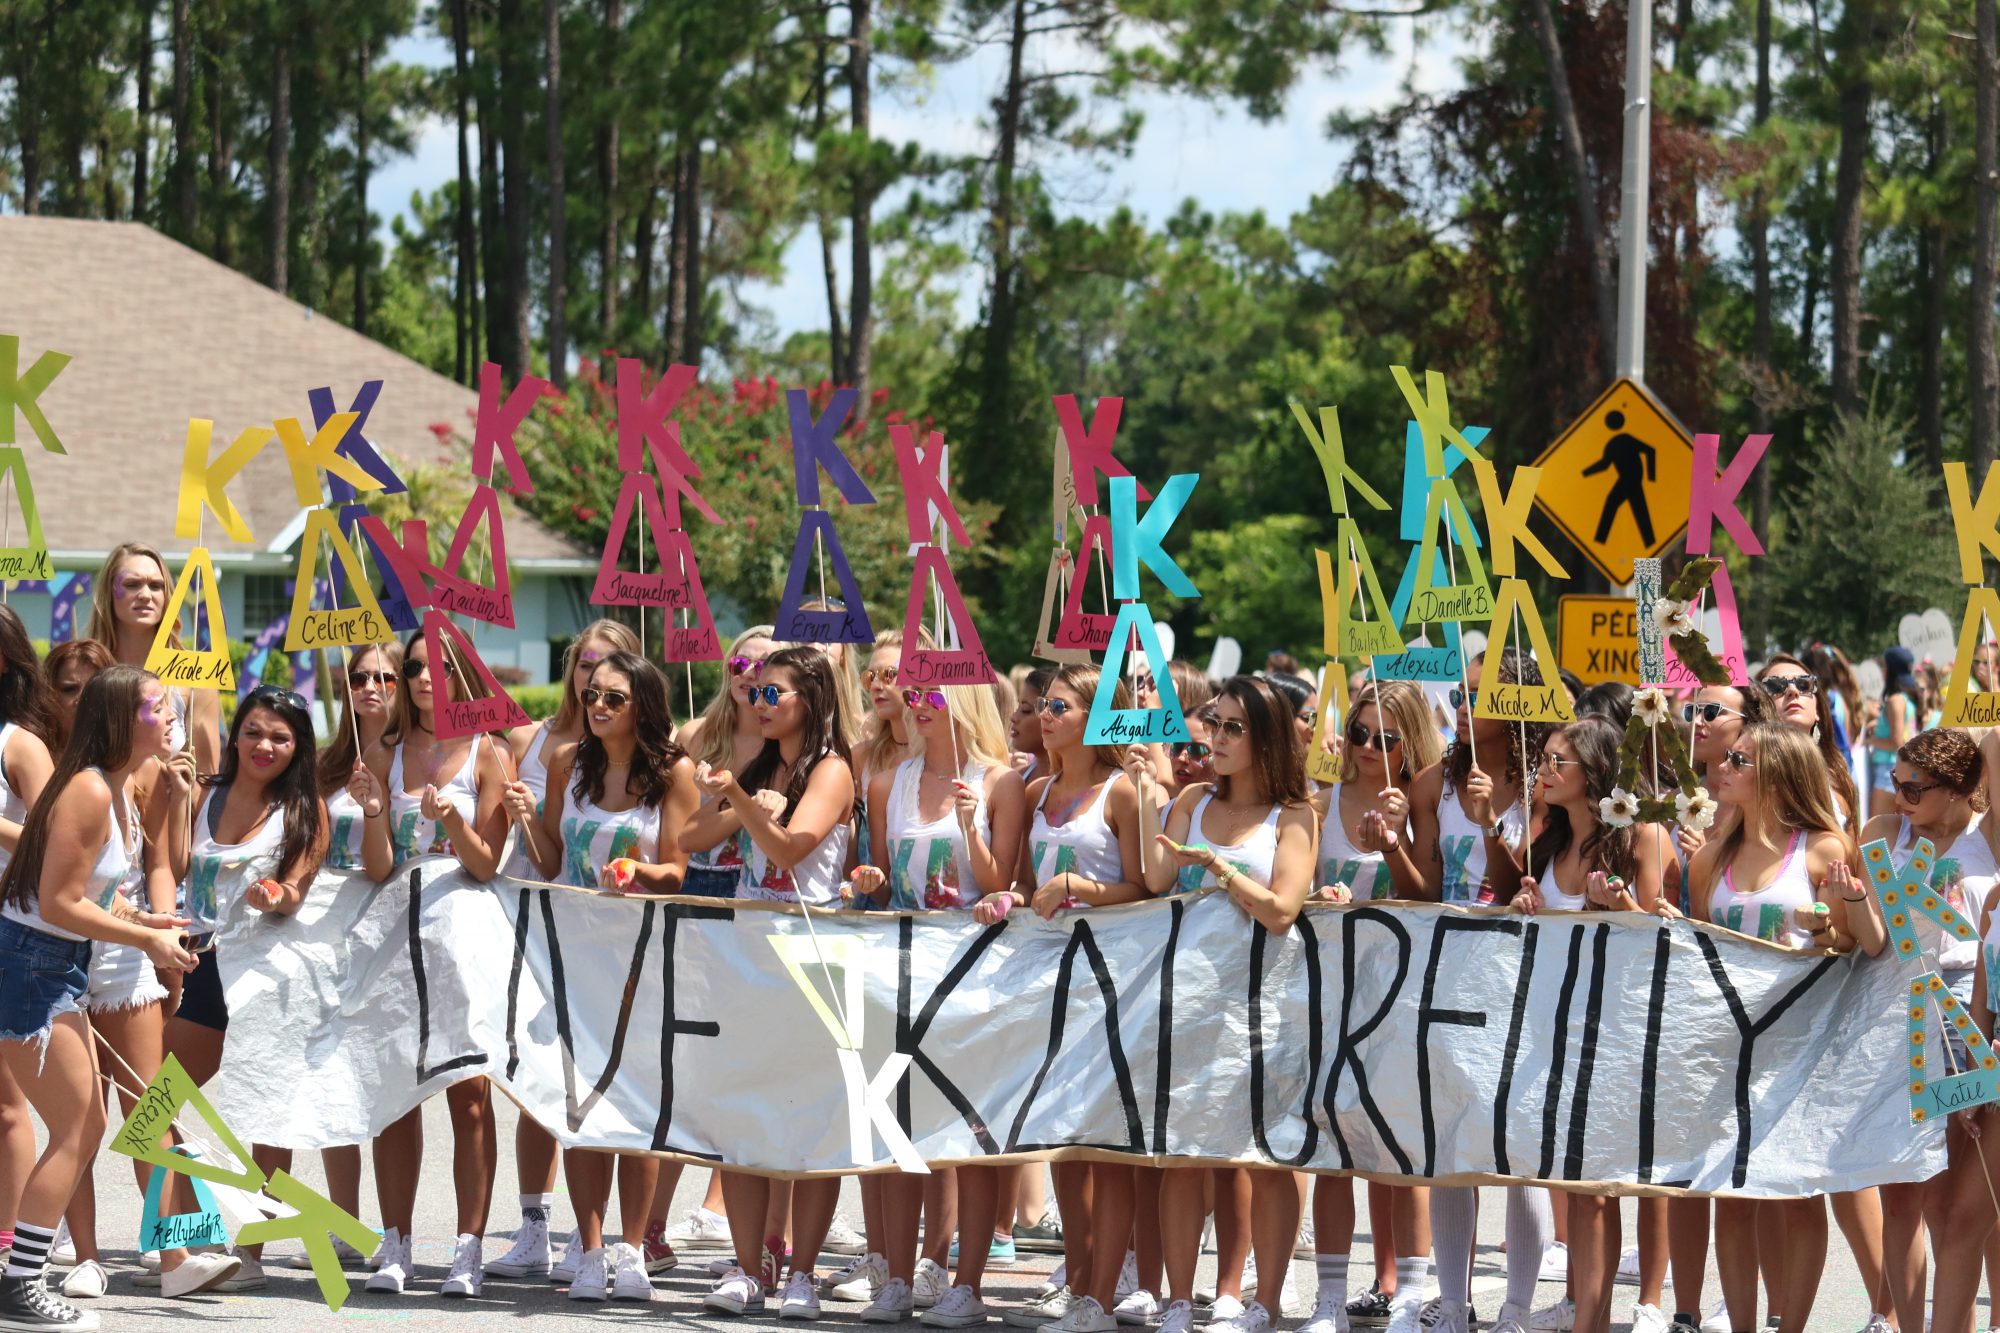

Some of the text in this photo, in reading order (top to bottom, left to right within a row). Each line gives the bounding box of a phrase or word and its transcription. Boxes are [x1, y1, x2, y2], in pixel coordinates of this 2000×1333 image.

[273, 411, 386, 506] K
[786, 388, 877, 505] K
[175, 417, 276, 543] K
[1685, 433, 1774, 555] K
[1472, 459, 1571, 578] K
[1109, 473, 1202, 599] K
[603, 574, 681, 606] Jacqueline
[1417, 586, 1489, 622] Danielle B.
[302, 613, 357, 644] Celine
[358, 610, 382, 640] B.
[791, 614, 832, 642] Eryn
[1069, 616, 1112, 643] Shan
[1349, 627, 1379, 654] Bailey
[672, 630, 699, 660] Chloe
[156, 653, 229, 686] Nicole M.
[905, 653, 975, 683] Brianna
[1386, 650, 1460, 681] Alexis C.
[445, 701, 526, 730] Victoria M.
[1487, 688, 1568, 720] Nicole M.
[1957, 694, 2000, 723] Nicole
[1101, 710, 1180, 743] Abigail E.
[408, 866, 735, 1160] LIVE
[1930, 1081, 1985, 1112] Katie
